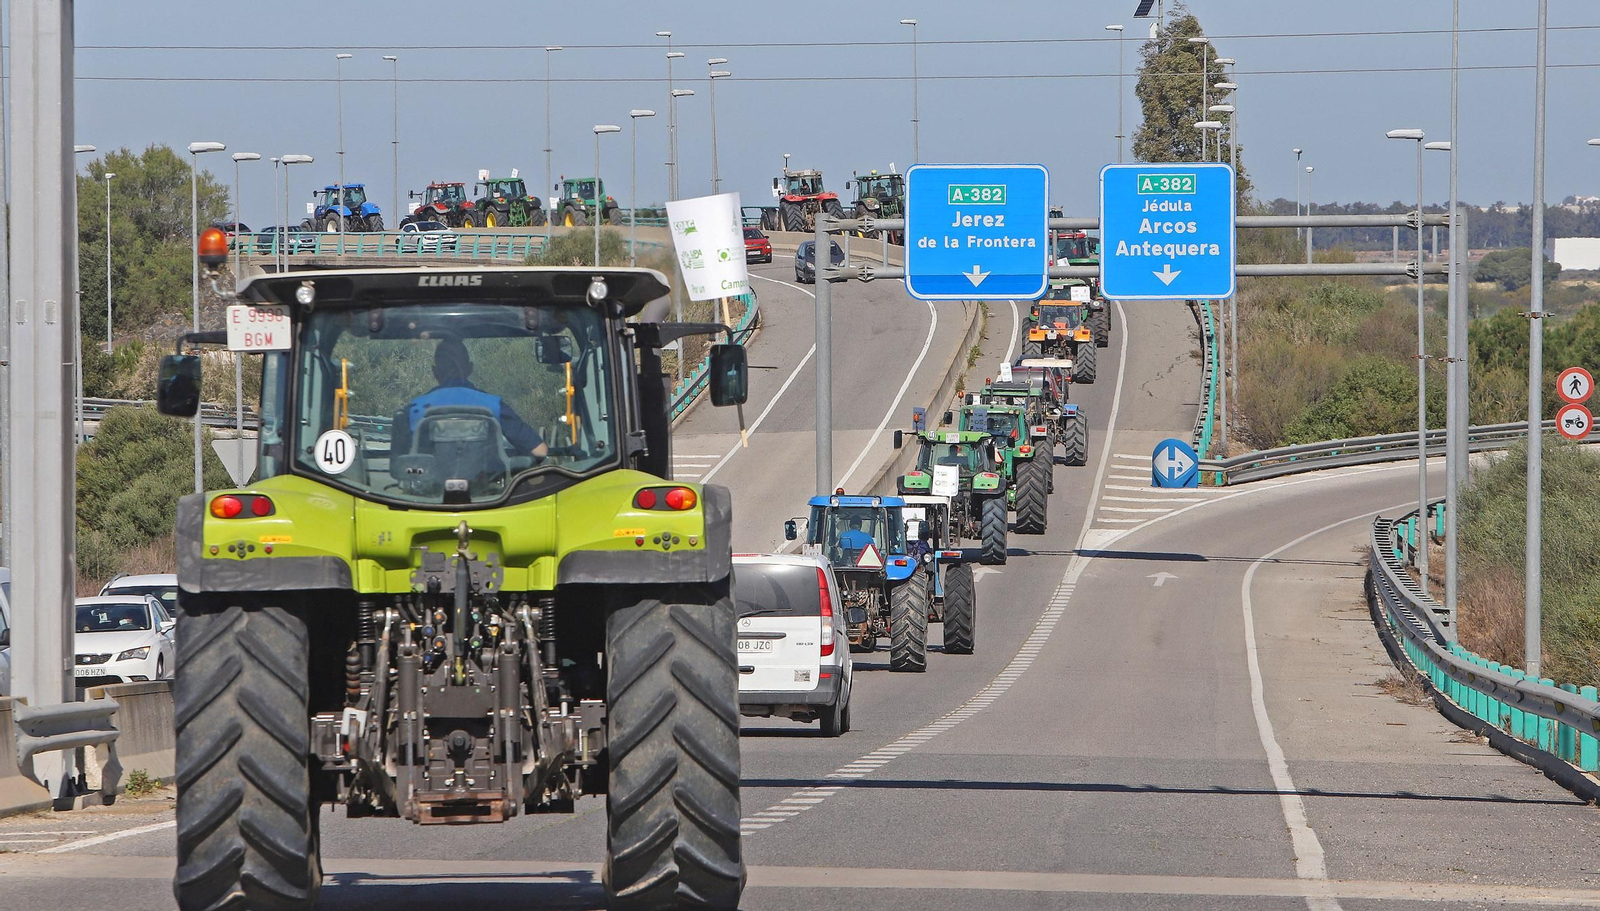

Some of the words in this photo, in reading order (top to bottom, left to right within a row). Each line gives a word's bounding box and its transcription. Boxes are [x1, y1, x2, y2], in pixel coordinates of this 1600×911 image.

[1142, 177, 1192, 191] A-382
[952, 188, 1002, 201] A-382
[1142, 199, 1192, 212] Jédula
[951, 211, 1005, 227] Jerez
[1139, 218, 1197, 234] Arcos
[917, 236, 937, 248] de
[944, 236, 960, 248] la
[967, 235, 1036, 248] Frontera
[1115, 240, 1220, 259] Antequera
[417, 275, 483, 287] CLAAS
[232, 309, 241, 324] E
[244, 332, 273, 347] BGM
[324, 438, 346, 465] 40
[753, 641, 771, 650] JZC
